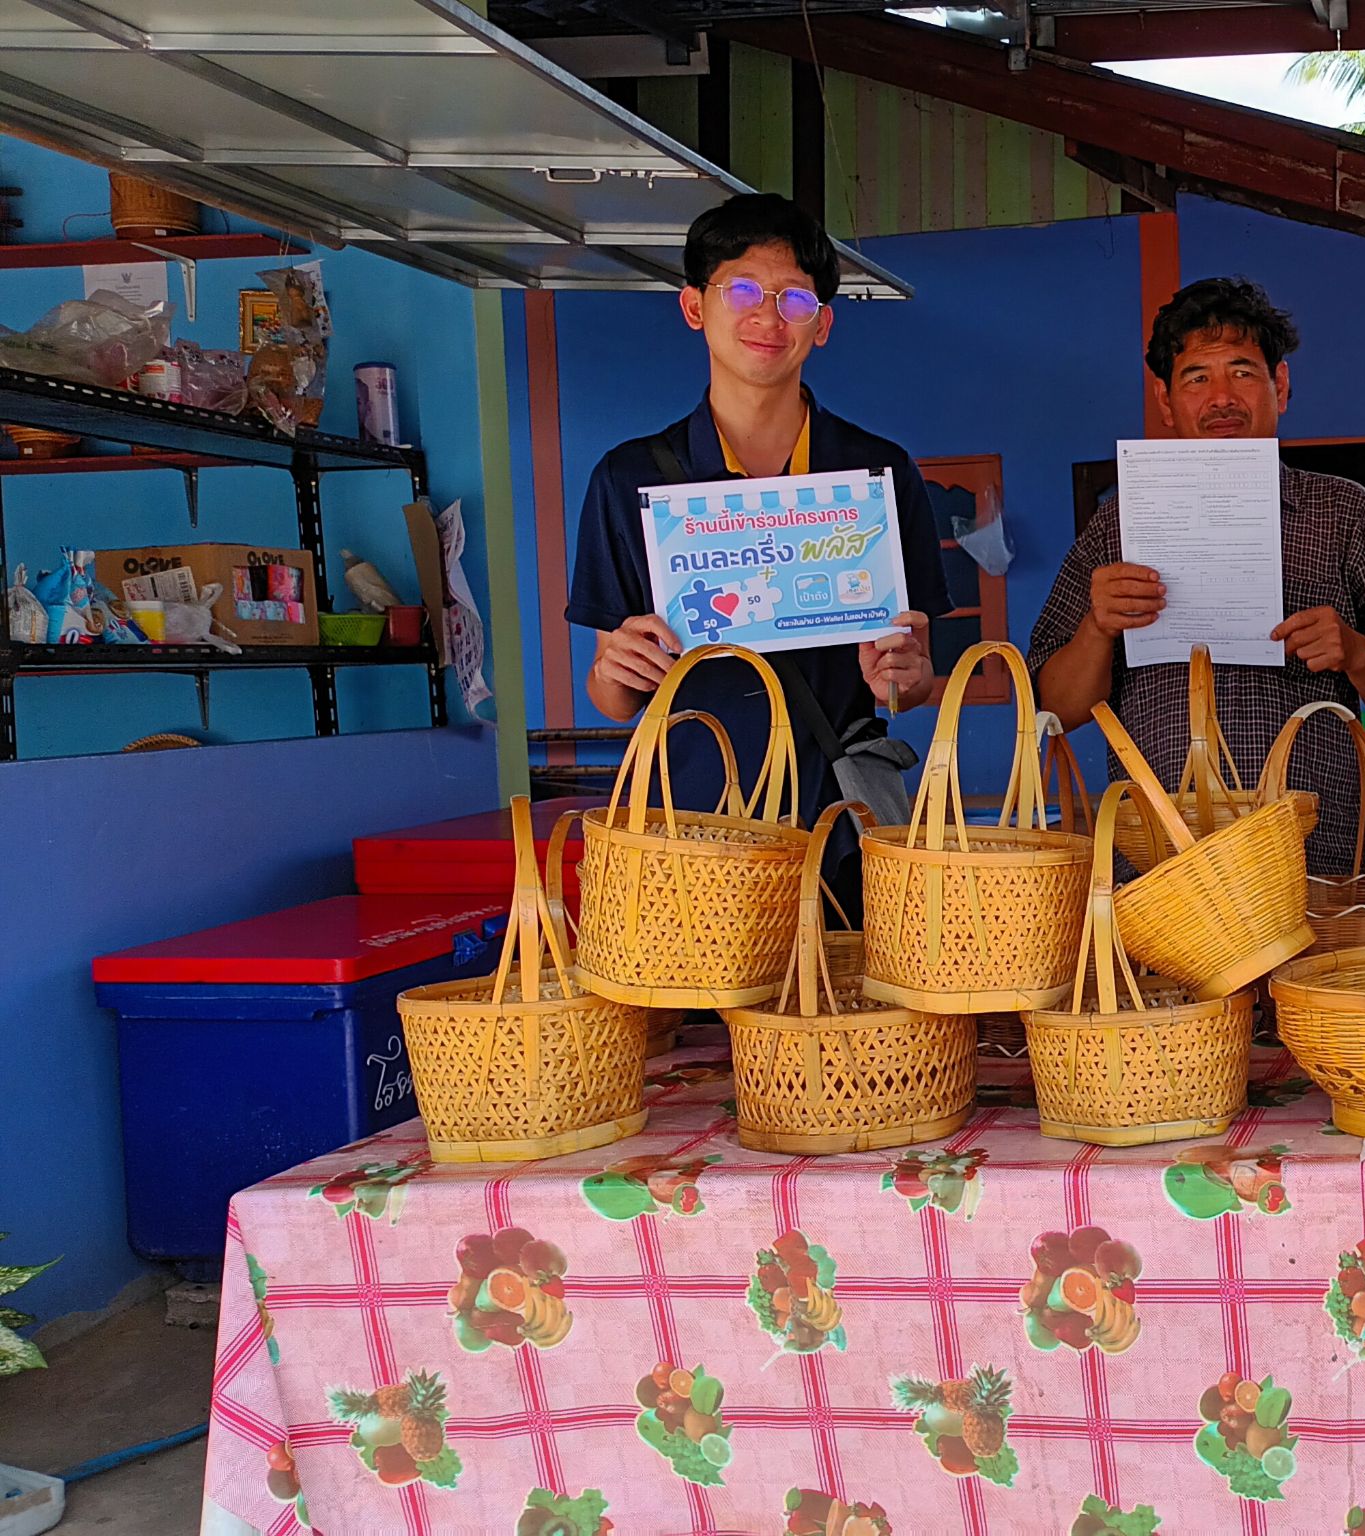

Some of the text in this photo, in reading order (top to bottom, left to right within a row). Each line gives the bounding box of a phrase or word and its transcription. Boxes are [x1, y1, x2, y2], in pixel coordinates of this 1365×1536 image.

[684, 506, 858, 535] ร้านนี้เข้าร่วมโครงการ
[670, 525, 882, 573] คนละครึ่ง พลัส
[747, 594, 761, 605] 50
[703, 619, 717, 629] 50
